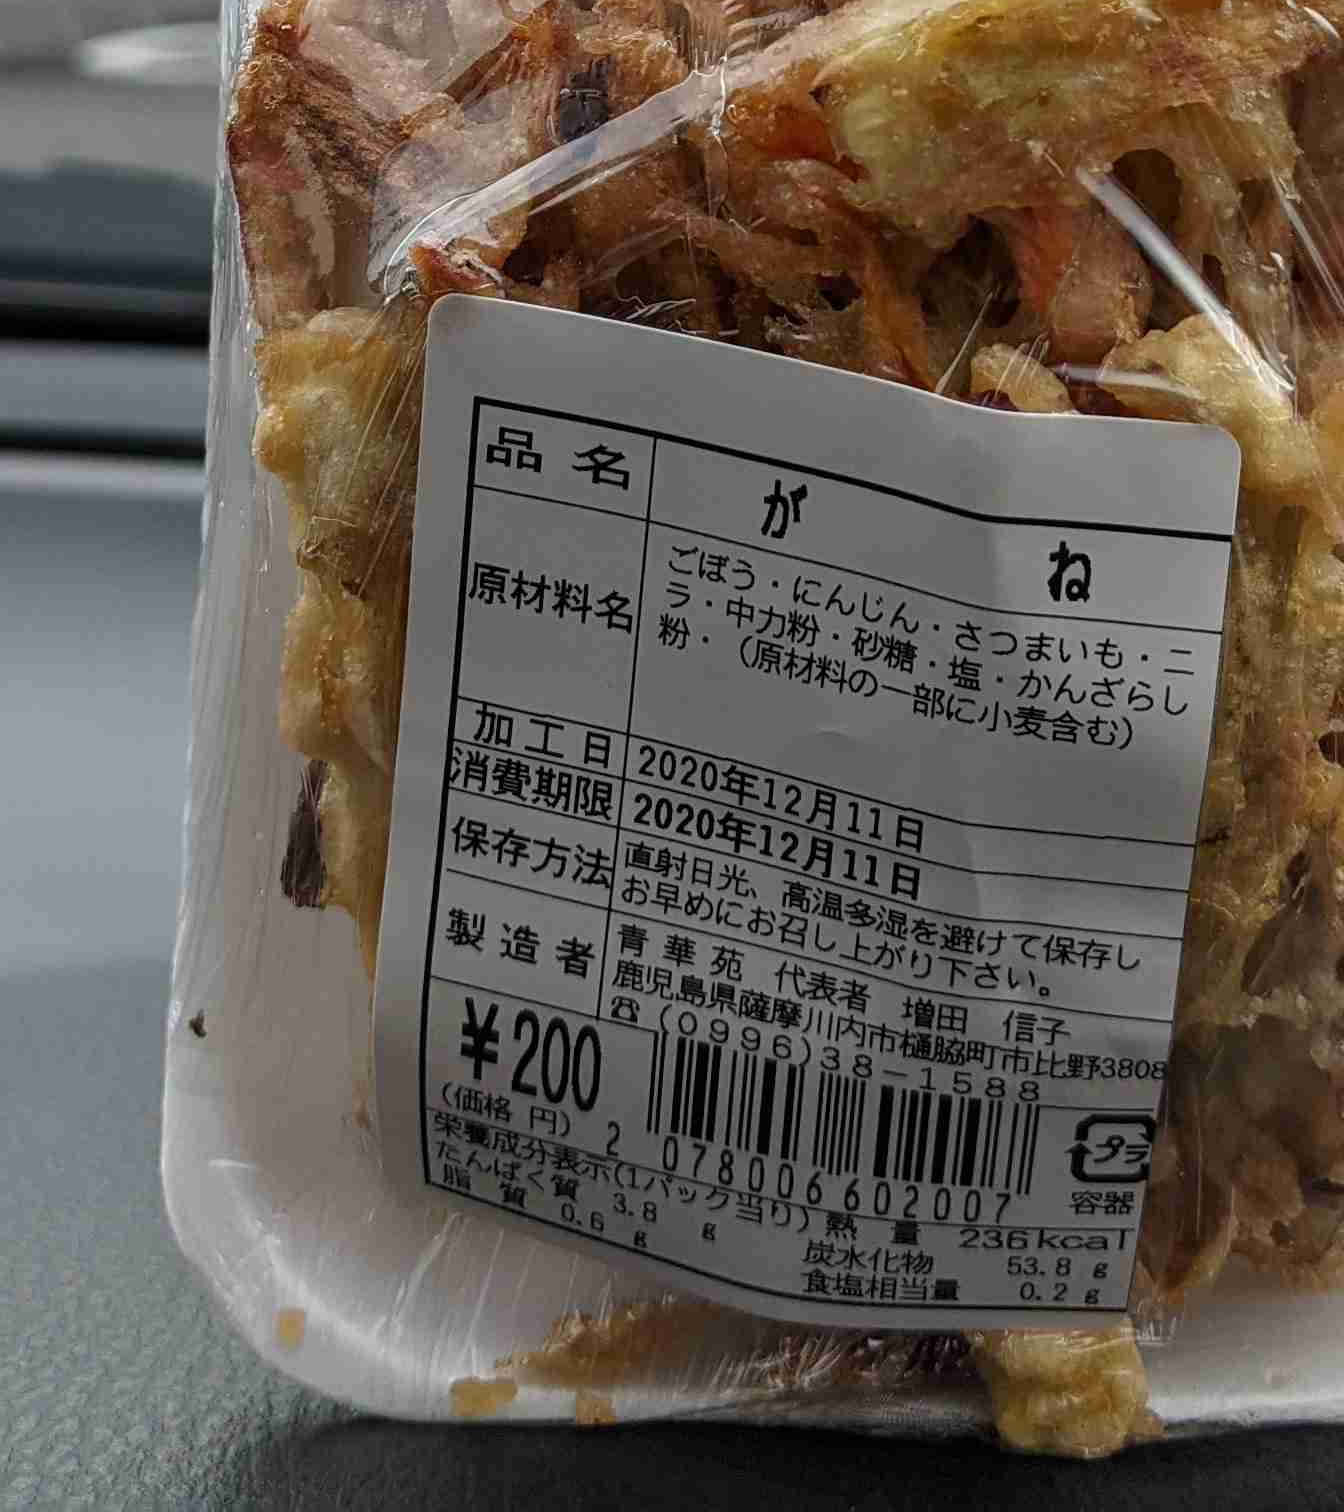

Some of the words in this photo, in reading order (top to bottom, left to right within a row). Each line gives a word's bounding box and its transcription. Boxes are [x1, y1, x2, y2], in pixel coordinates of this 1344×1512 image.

[485, 426, 631, 491] 品名
[468, 561, 634, 635] 原材料名
[473, 702, 612, 769] 加工日
[450, 747, 614, 822] 消費期限
[638, 744, 924, 854] 2020年12月11日
[451, 815, 614, 889] 保存方法
[633, 792, 921, 901] 2020年12月11日
[445, 907, 595, 979] 製造者
[773, 959, 872, 1015] 代表者
[459, 996, 602, 1112] ¥200
[1069, 1190, 1137, 1217] 容器
[800, 1239, 935, 1275] 炭水化物
[800, 1267, 960, 1304] 食塩相当量
